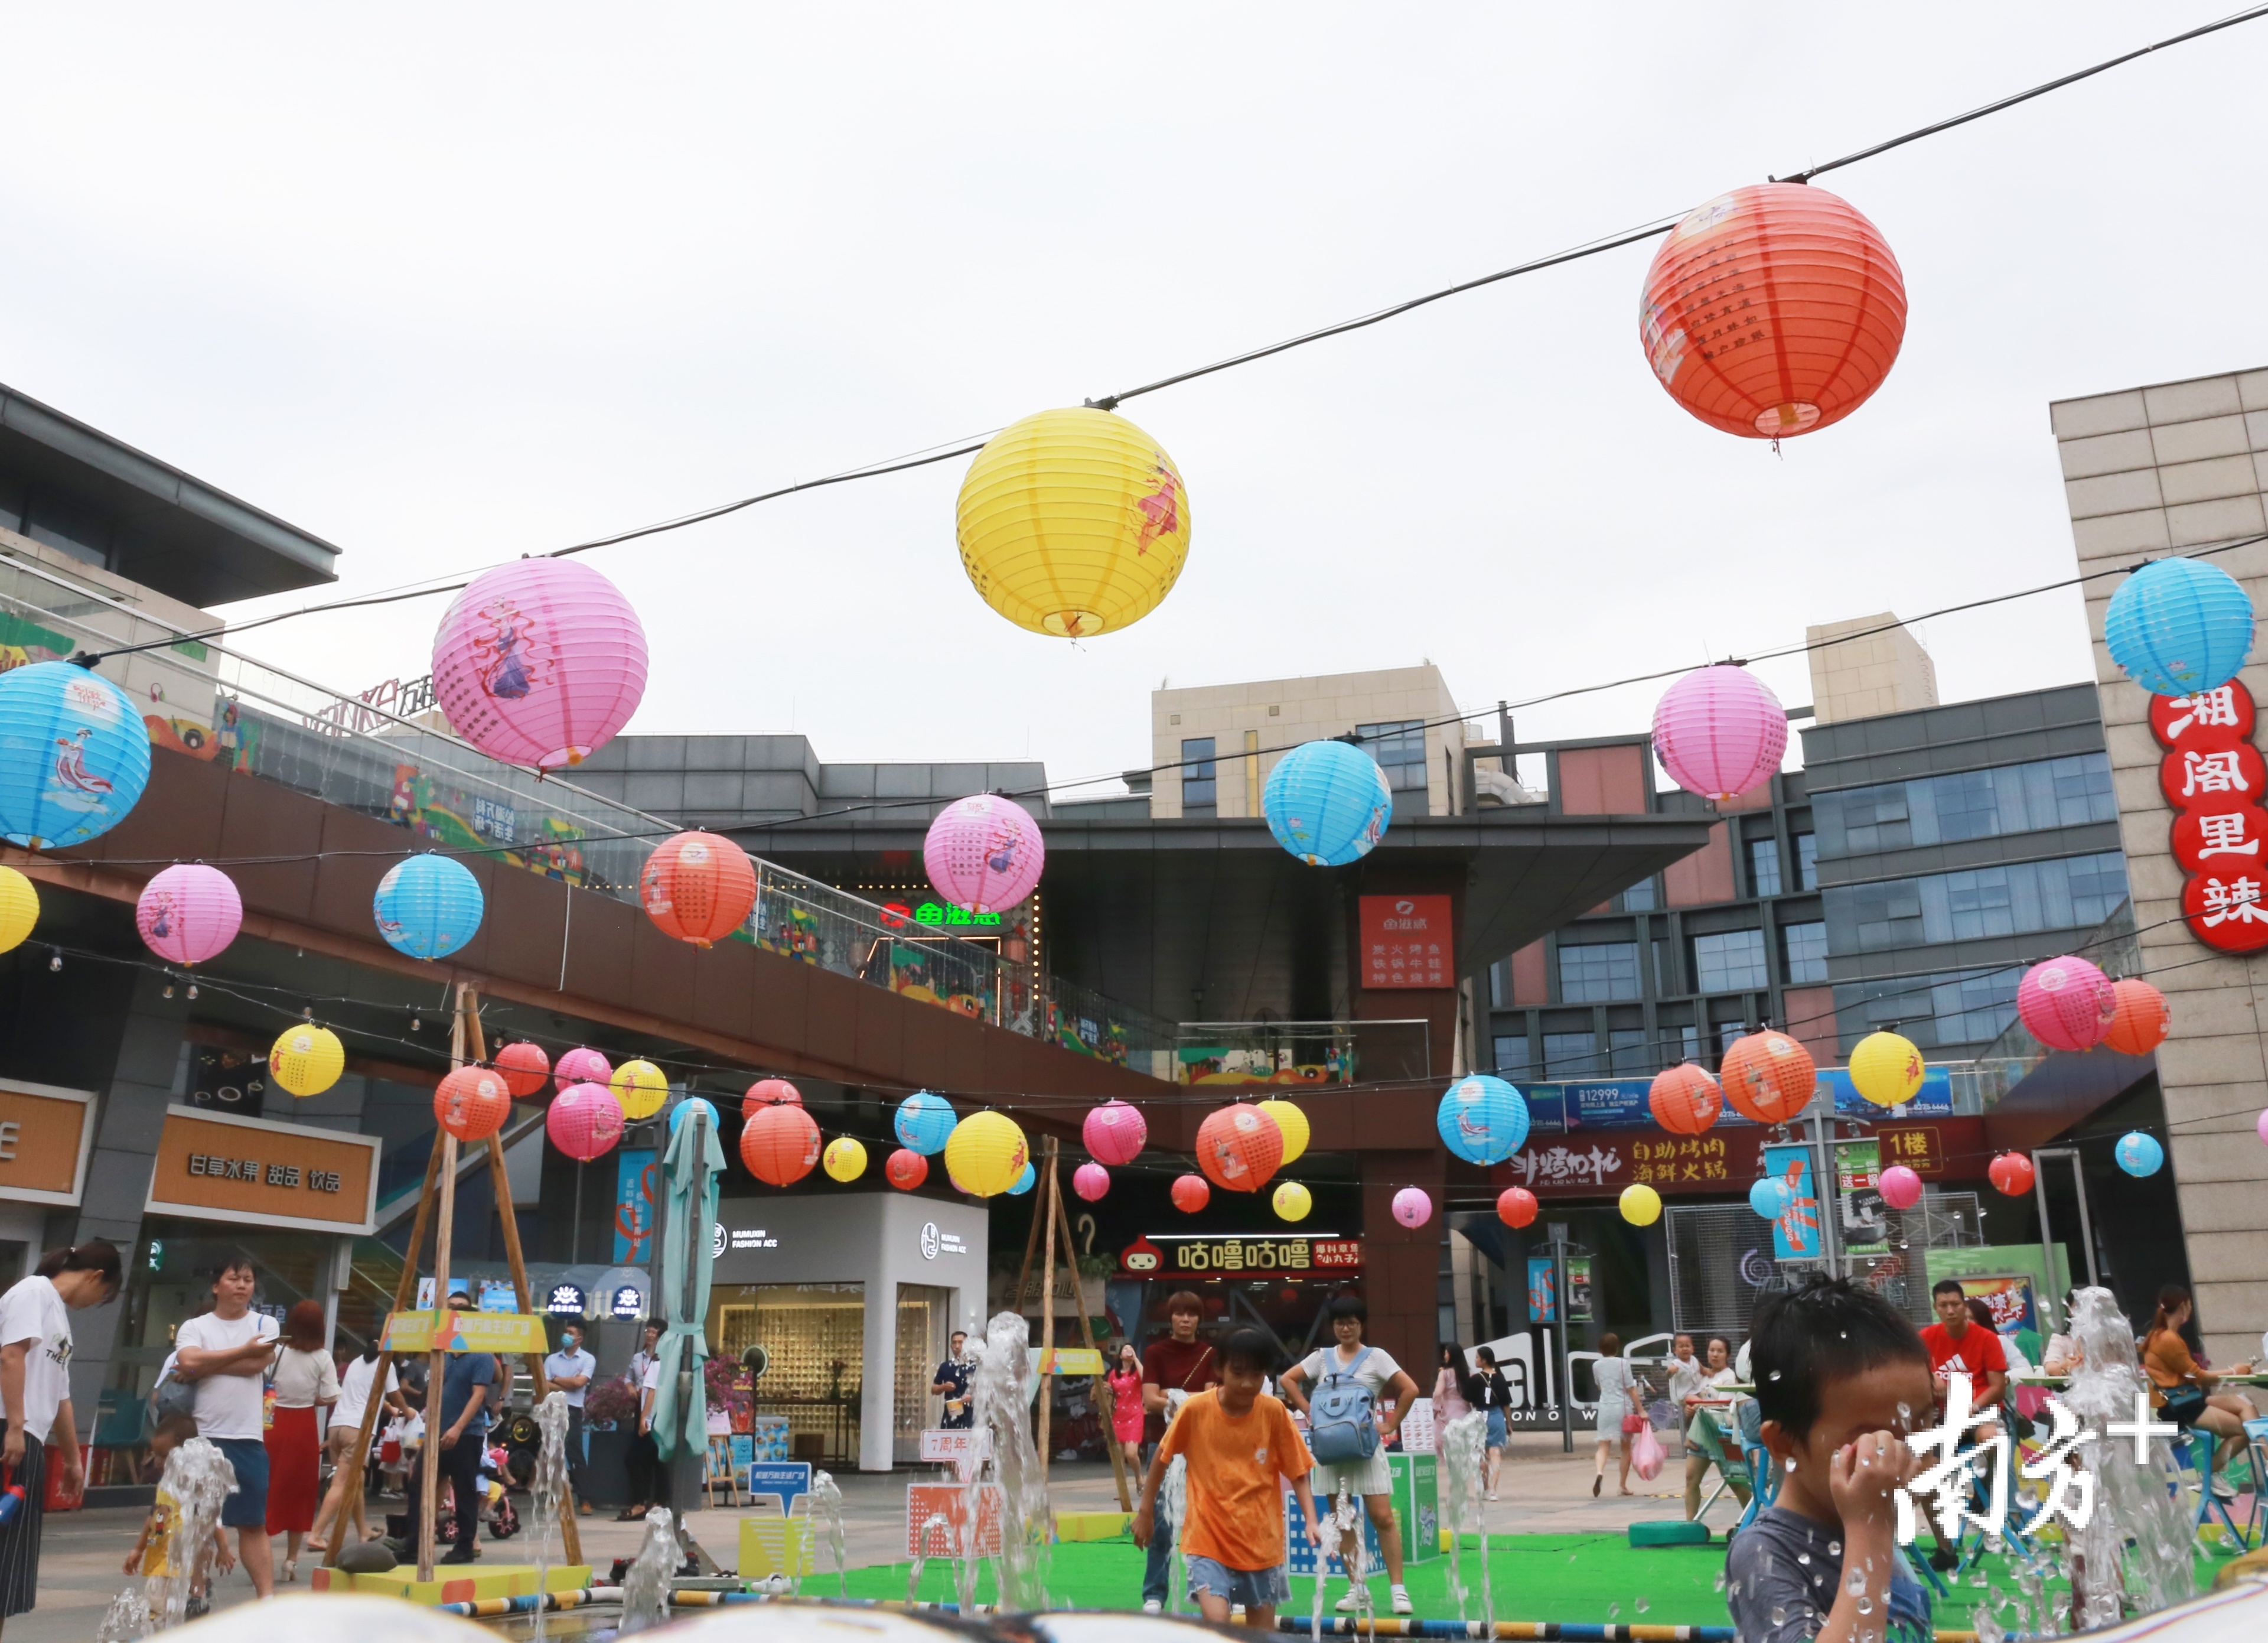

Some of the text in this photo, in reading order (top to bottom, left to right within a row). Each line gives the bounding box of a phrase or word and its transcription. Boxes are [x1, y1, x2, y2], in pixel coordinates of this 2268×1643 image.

[2167, 687, 2268, 927] 湘阁里辣
[1373, 944, 1440, 955] 炭火烤鱼
[1373, 958, 1441, 968] 铁锅牛蛙
[1373, 972, 1442, 983] 特色烧烤
[1586, 1088, 1618, 1101] 12999
[1632, 1138, 1725, 1160] 自助烤肉
[1890, 1132, 1927, 1155] 1楼
[190, 1154, 340, 1192] 甘草水果 甜品 饮品
[1632, 1161, 1727, 1182] 海鲜火锅
[1842, 1174, 1879, 1187] 送一锅
[732, 1230, 766, 1238] MUMUXIN
[732, 1239, 777, 1248] FASHION ACC
[1178, 1239, 1309, 1270] 咕噜咕噜
